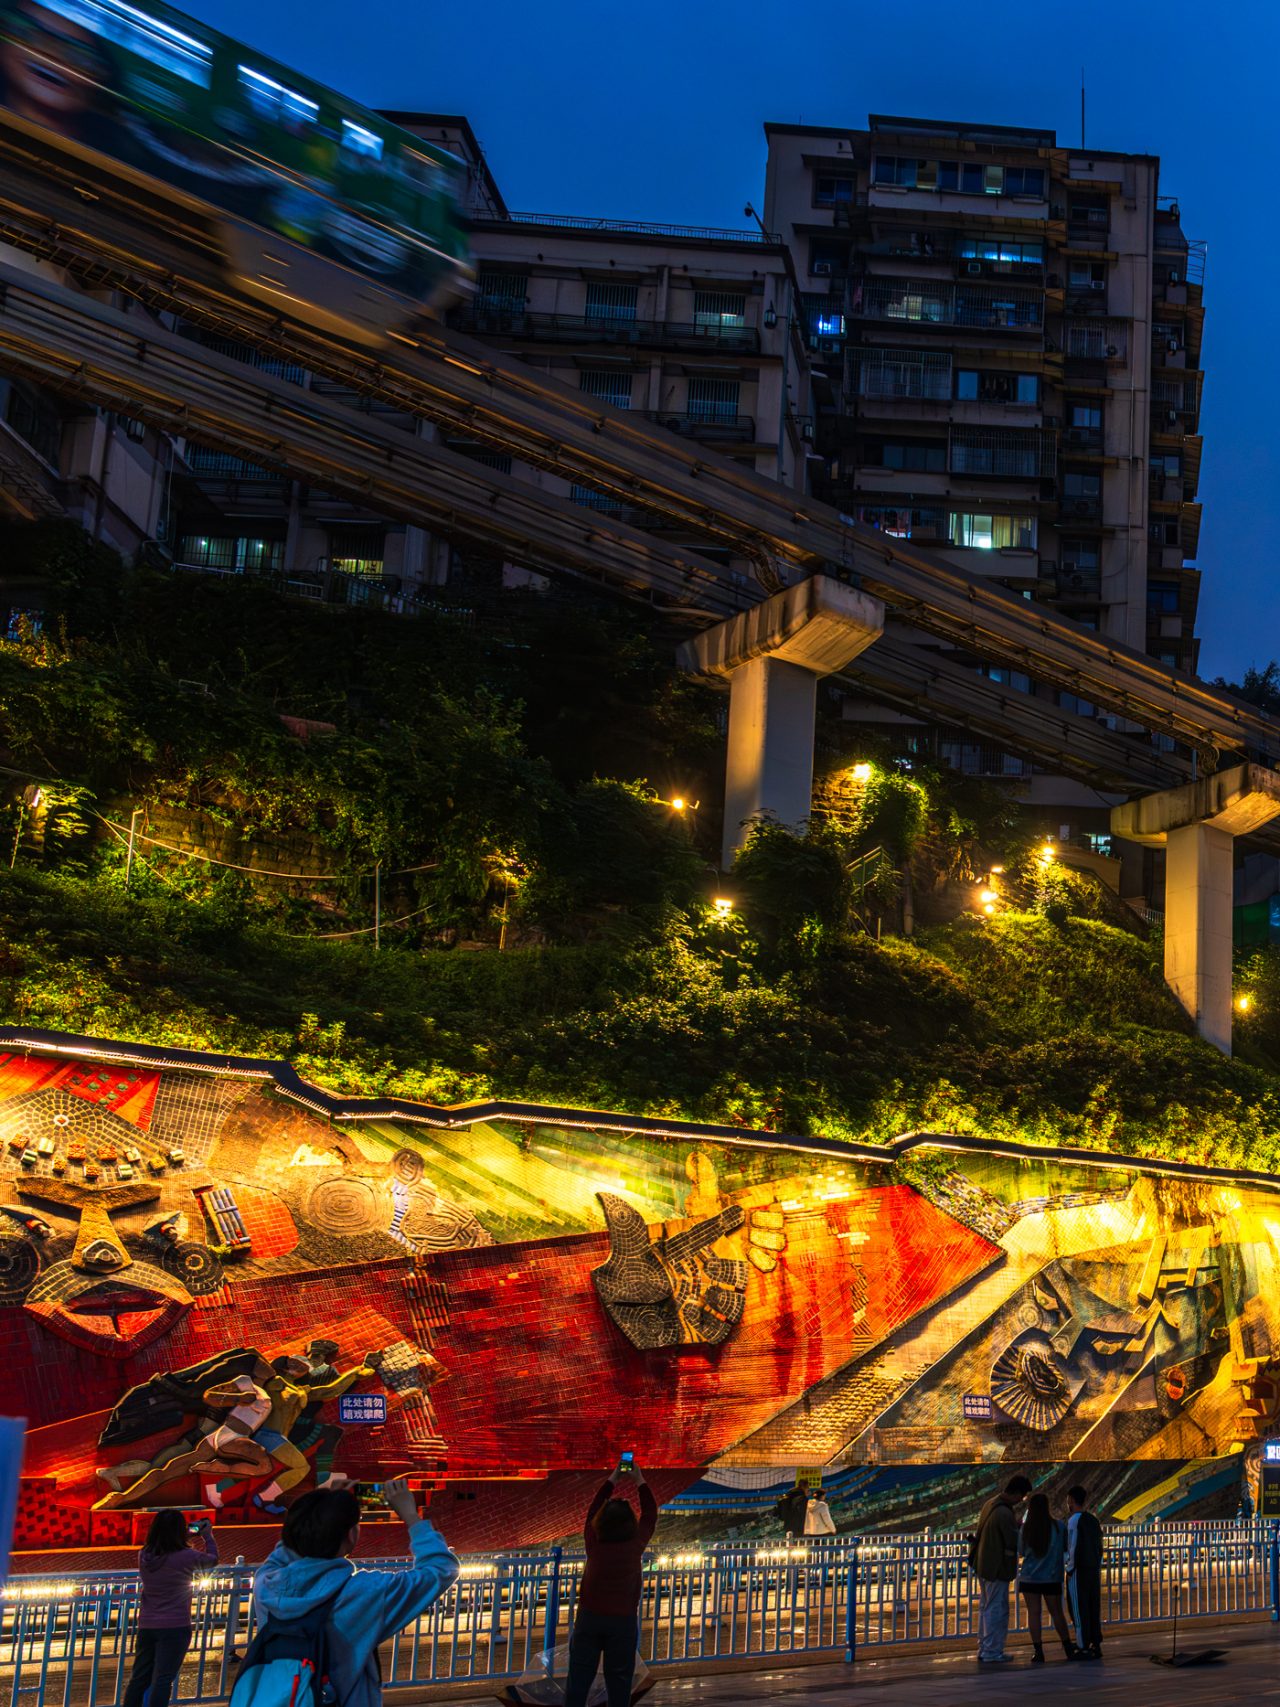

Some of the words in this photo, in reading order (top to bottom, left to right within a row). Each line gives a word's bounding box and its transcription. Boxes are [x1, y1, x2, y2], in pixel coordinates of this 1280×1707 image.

[342, 1396, 383, 1408] 此处请勿
[964, 1397, 990, 1407] 此处请勿
[342, 1408, 385, 1420] 嬉戏攀爬
